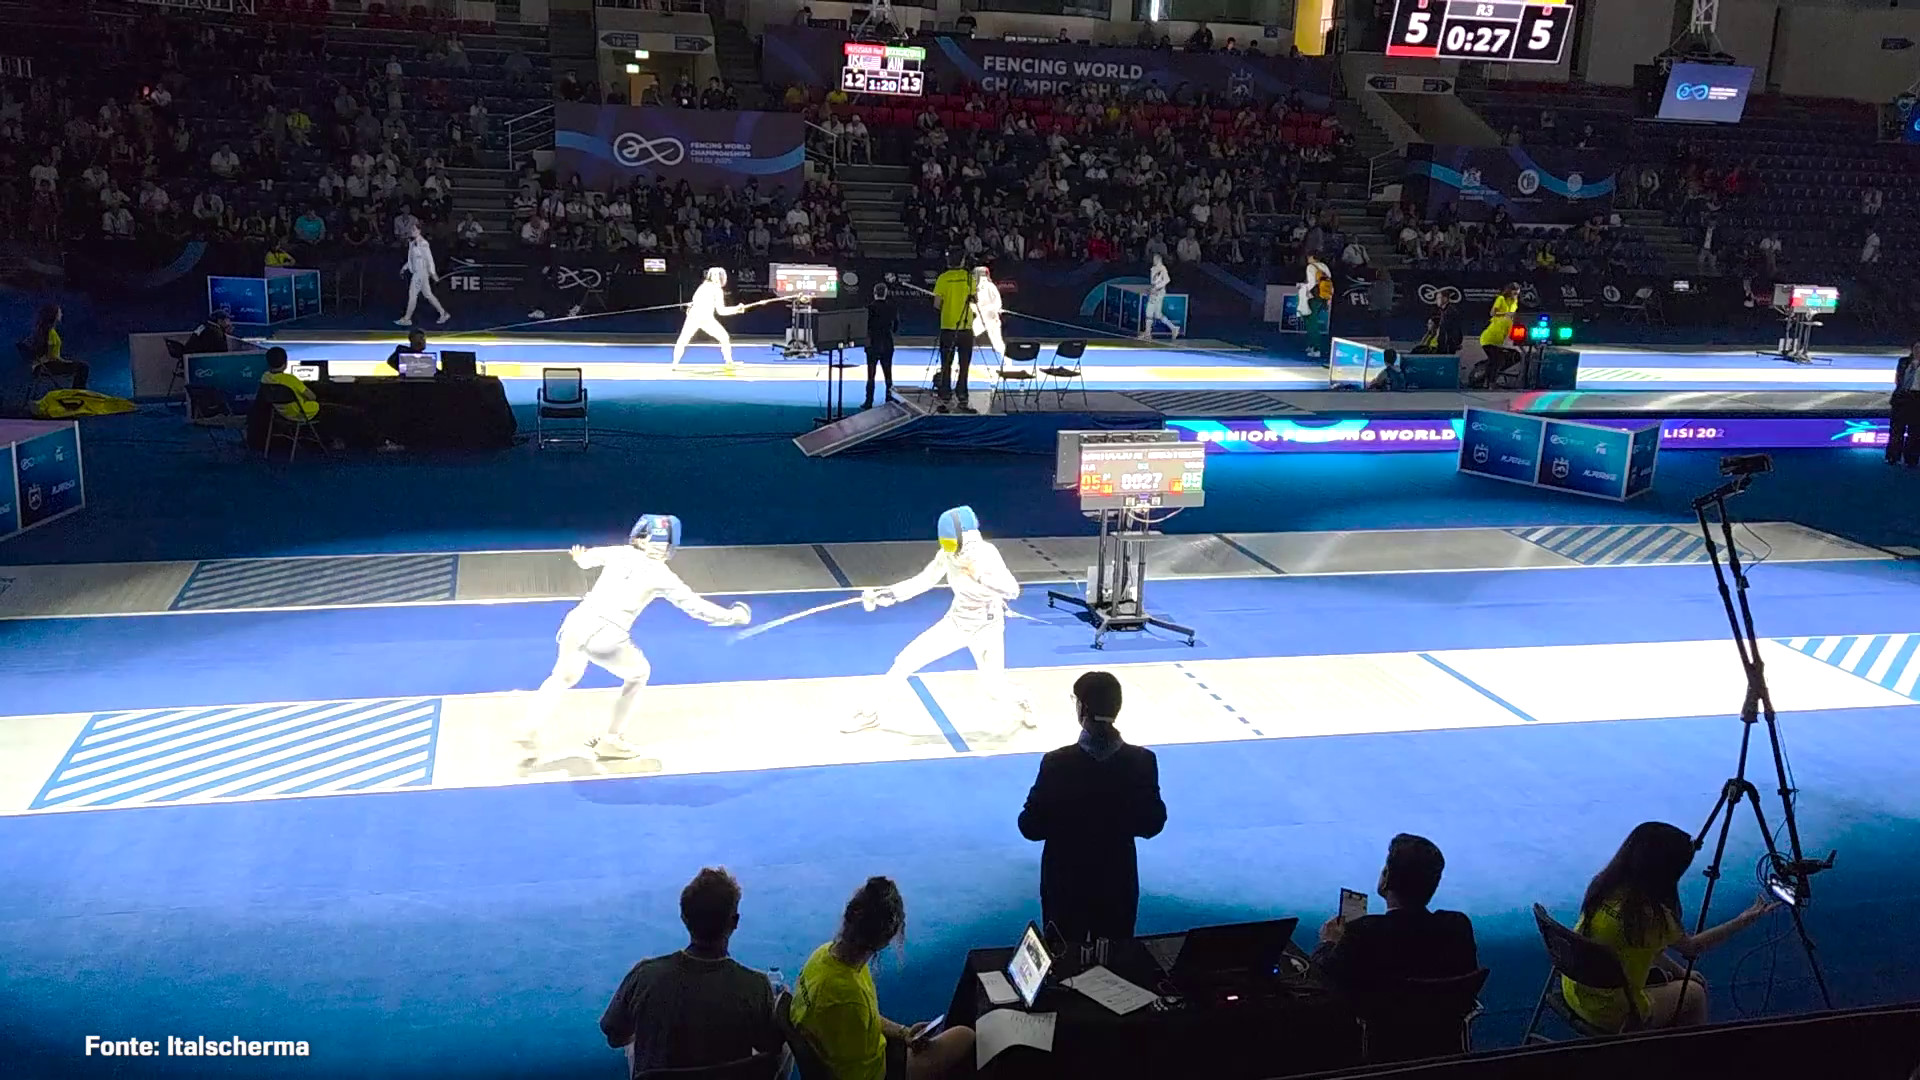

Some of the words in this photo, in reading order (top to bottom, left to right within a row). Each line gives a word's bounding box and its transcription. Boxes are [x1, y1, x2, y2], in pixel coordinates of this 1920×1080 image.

[1476, 4, 1495, 17] R3
[1405, 12, 1431, 43] 5
[1446, 26, 1511, 53] 0:27
[1528, 19, 1554, 50] 5
[983, 55, 1068, 75] FENCING
[1074, 61, 1144, 80] WORLD
[844, 73, 865, 87] 12
[869, 79, 897, 91] 1:20
[901, 77, 921, 91] 13
[451, 275, 481, 290] FIE
[1380, 428, 1456, 441] WORLD
